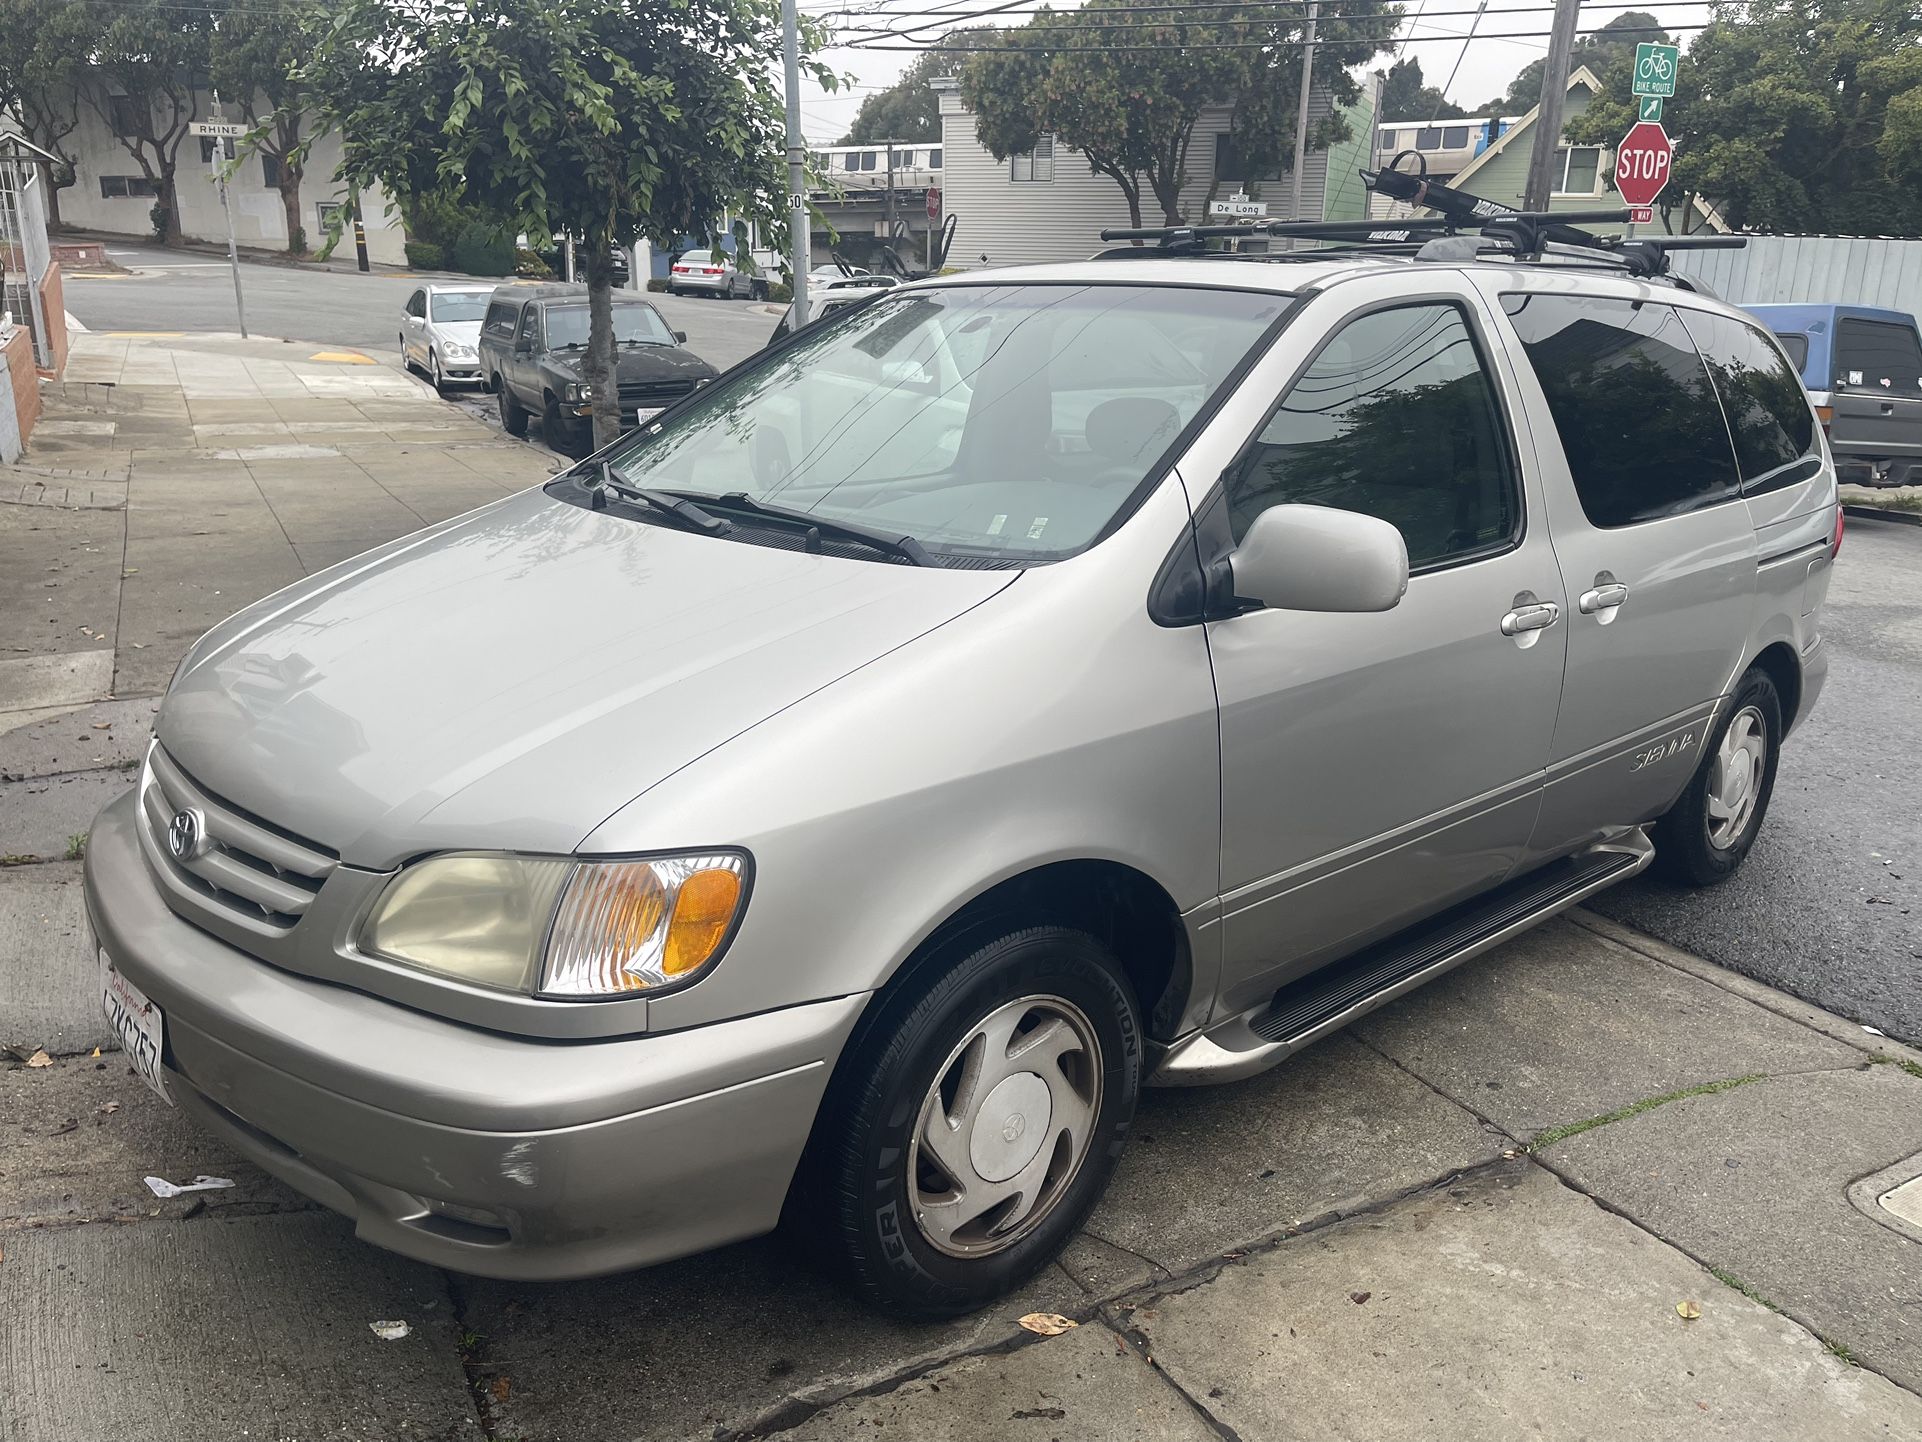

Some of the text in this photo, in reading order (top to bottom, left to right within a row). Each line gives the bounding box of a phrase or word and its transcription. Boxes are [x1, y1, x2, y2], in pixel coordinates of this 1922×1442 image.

[1636, 81, 1671, 93] BIKE ROUTE
[200, 125, 238, 135] RHINE
[1618, 148, 1669, 180] STOP
[927, 196, 939, 209] STOP
[1217, 204, 1259, 215] De Long
[1637, 210, 1651, 221] WAY
[1628, 730, 1697, 773] SIENNA
